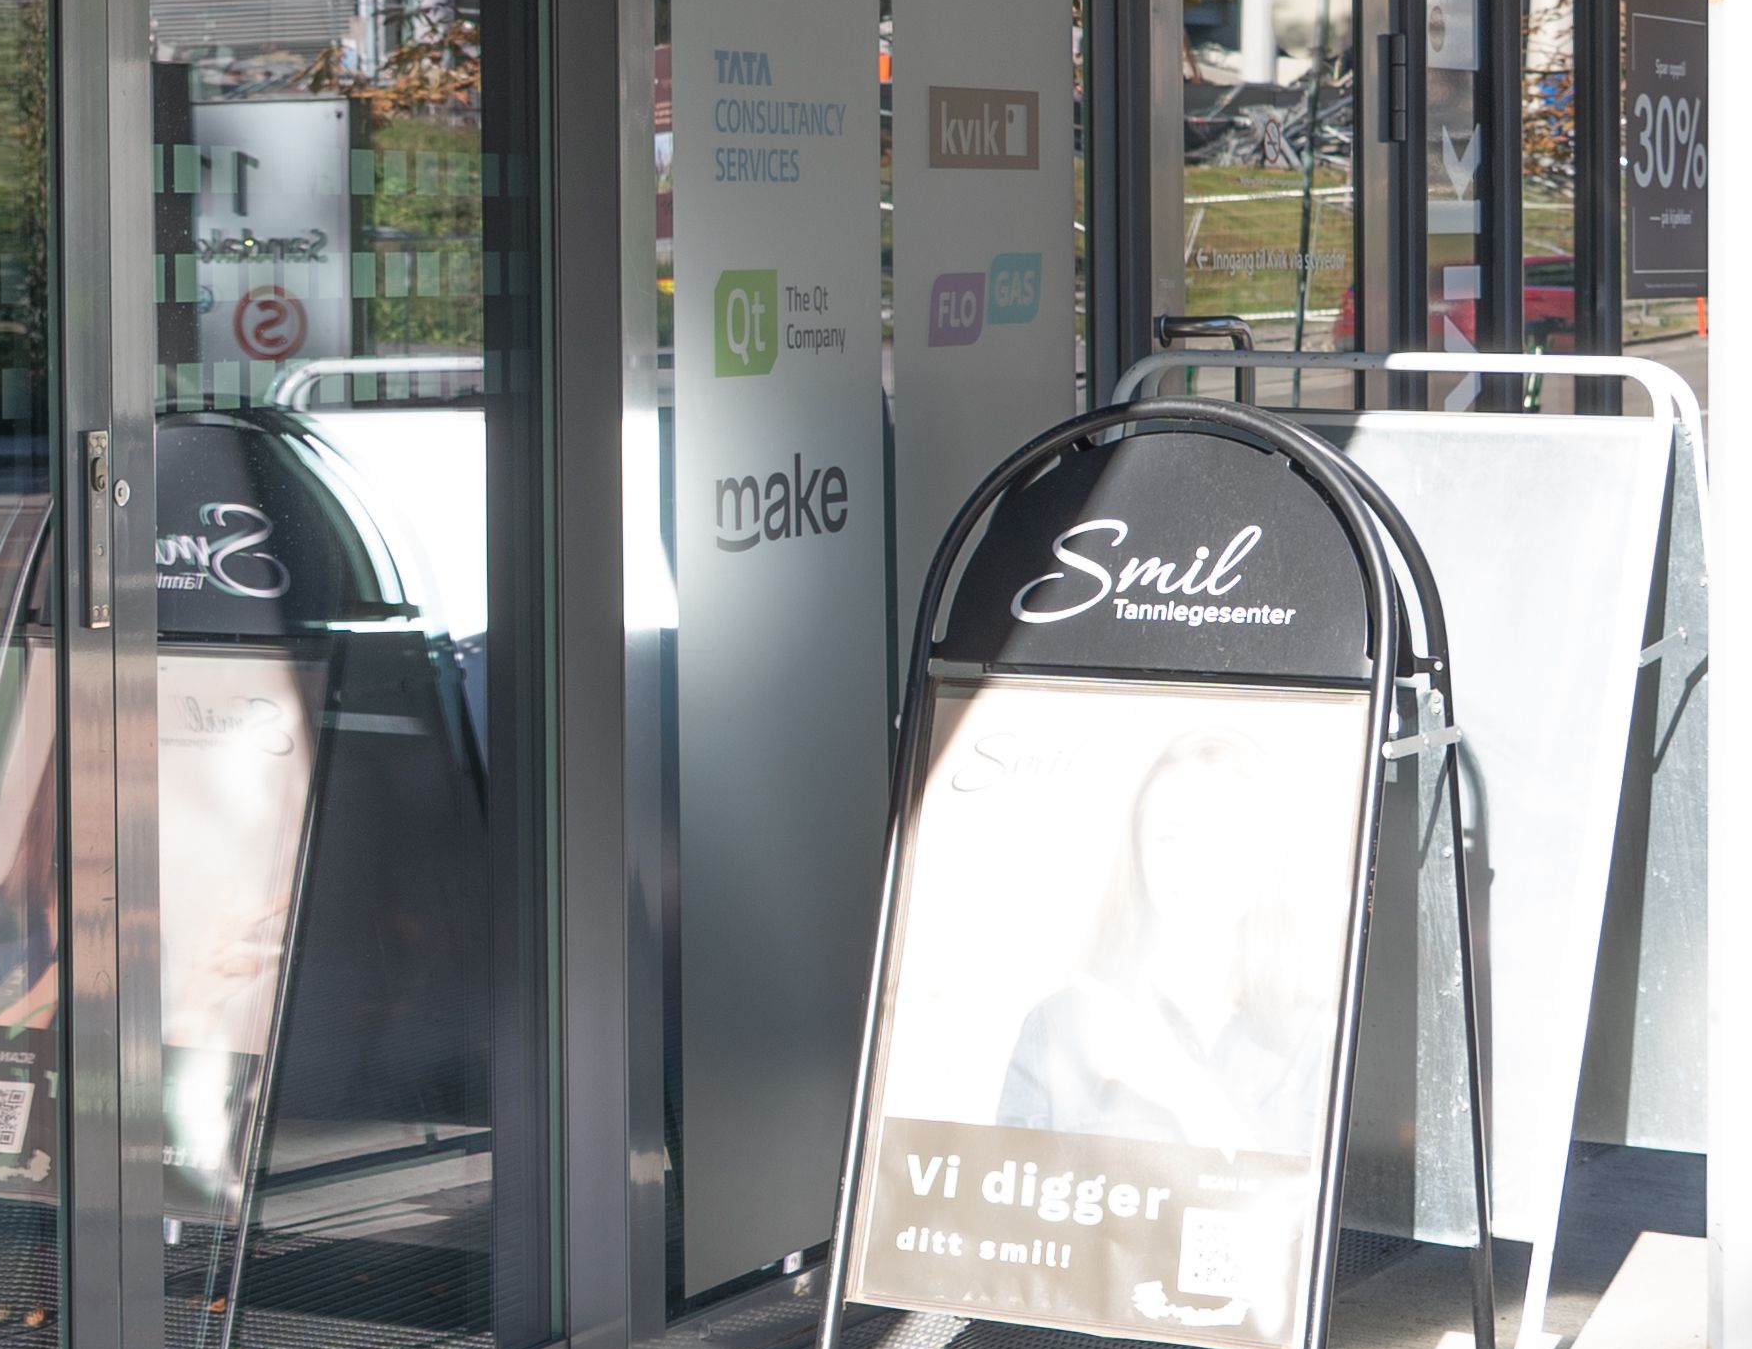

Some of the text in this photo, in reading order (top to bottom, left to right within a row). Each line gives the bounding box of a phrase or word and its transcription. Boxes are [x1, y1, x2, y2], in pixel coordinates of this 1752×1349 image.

[715, 51, 772, 85] TATA
[715, 100, 847, 138] CONSULTANCY
[941, 101, 999, 157] kvik
[1633, 93, 1707, 190] 30%
[715, 148, 800, 184] SERVICES
[1213, 248, 1345, 276] Inngang til Kvik via skyvedør
[786, 286, 829, 317] The Qt
[995, 268, 1036, 308] GAS
[725, 285, 768, 366] Qt
[938, 289, 977, 329] FLO
[786, 323, 847, 355] Company
[715, 453, 849, 552] make
[1010, 518, 1263, 624] Smil
[1113, 597, 1296, 626] Tannlegesenter
[906, 1154, 1171, 1226] Vi digger
[896, 1226, 1072, 1269] ditt smil!
